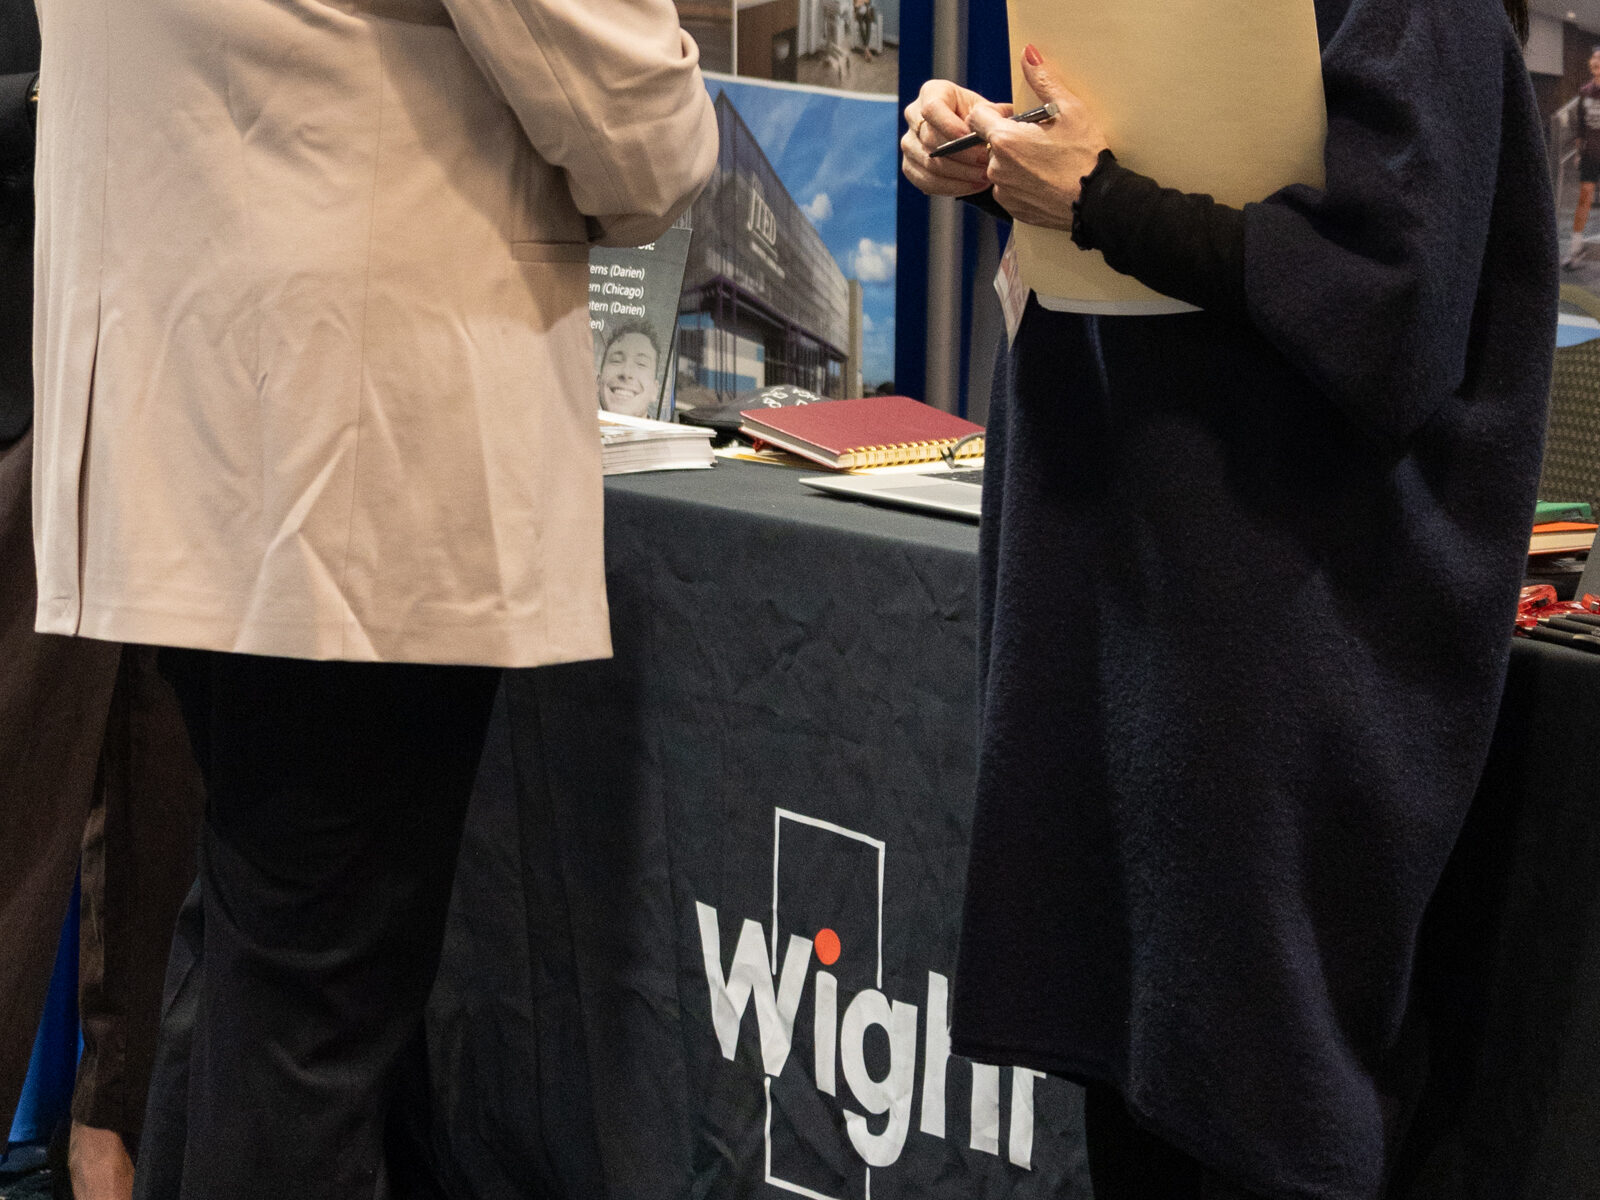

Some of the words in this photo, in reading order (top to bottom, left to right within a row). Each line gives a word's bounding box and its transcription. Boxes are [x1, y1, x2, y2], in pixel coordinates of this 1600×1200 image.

[588, 264, 609, 276] erns
[610, 264, 645, 280] (Darien)
[602, 281, 644, 300] (Chicago)
[610, 301, 645, 318] (Darien)
